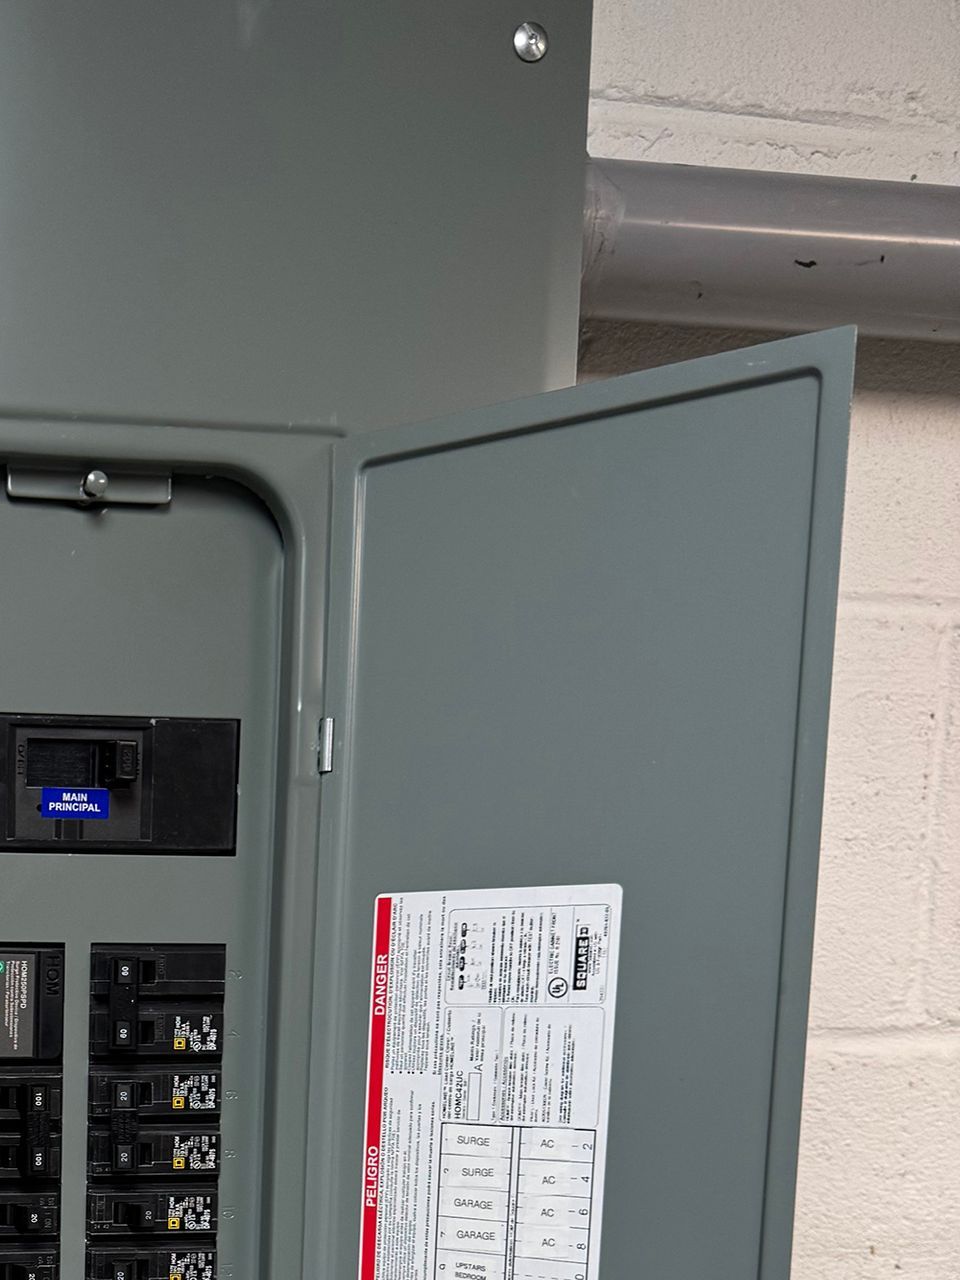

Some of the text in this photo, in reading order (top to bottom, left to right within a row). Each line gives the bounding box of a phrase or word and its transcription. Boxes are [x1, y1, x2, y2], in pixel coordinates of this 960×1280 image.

[62, 792, 88, 802] MAIN
[48, 802, 100, 812] PRINCIPAL
[576, 940, 588, 986] SQUARE
[46, 955, 60, 996] HOM
[121, 966, 129, 976] 60
[20, 960, 28, 1009] HOM250PSPD
[374, 954, 388, 1016] DANGER
[120, 1028, 128, 1038] 60
[474, 1064, 483, 1072] A
[120, 1091, 128, 1101] 20
[454, 1070, 464, 1119] HOMC42UC
[457, 1136, 490, 1146] SURGE
[540, 1139, 554, 1148] AC
[120, 1152, 128, 1162] 20
[366, 1146, 378, 1207] PELIGRO
[462, 1168, 494, 1177] SURGE
[542, 1176, 556, 1184] AC
[454, 1198, 493, 1210] GARAGE
[145, 1210, 152, 1220] 20
[540, 1208, 554, 1218] AC
[578, 1208, 588, 1216] 6
[30, 1213, 38, 1223] 20
[456, 1230, 496, 1240] GARAGE
[542, 1238, 556, 1247] AC
[456, 1262, 486, 1272] UPSTAIRS
[117, 1271, 124, 1280] 20
[454, 1272, 486, 1280] BEDROOM
